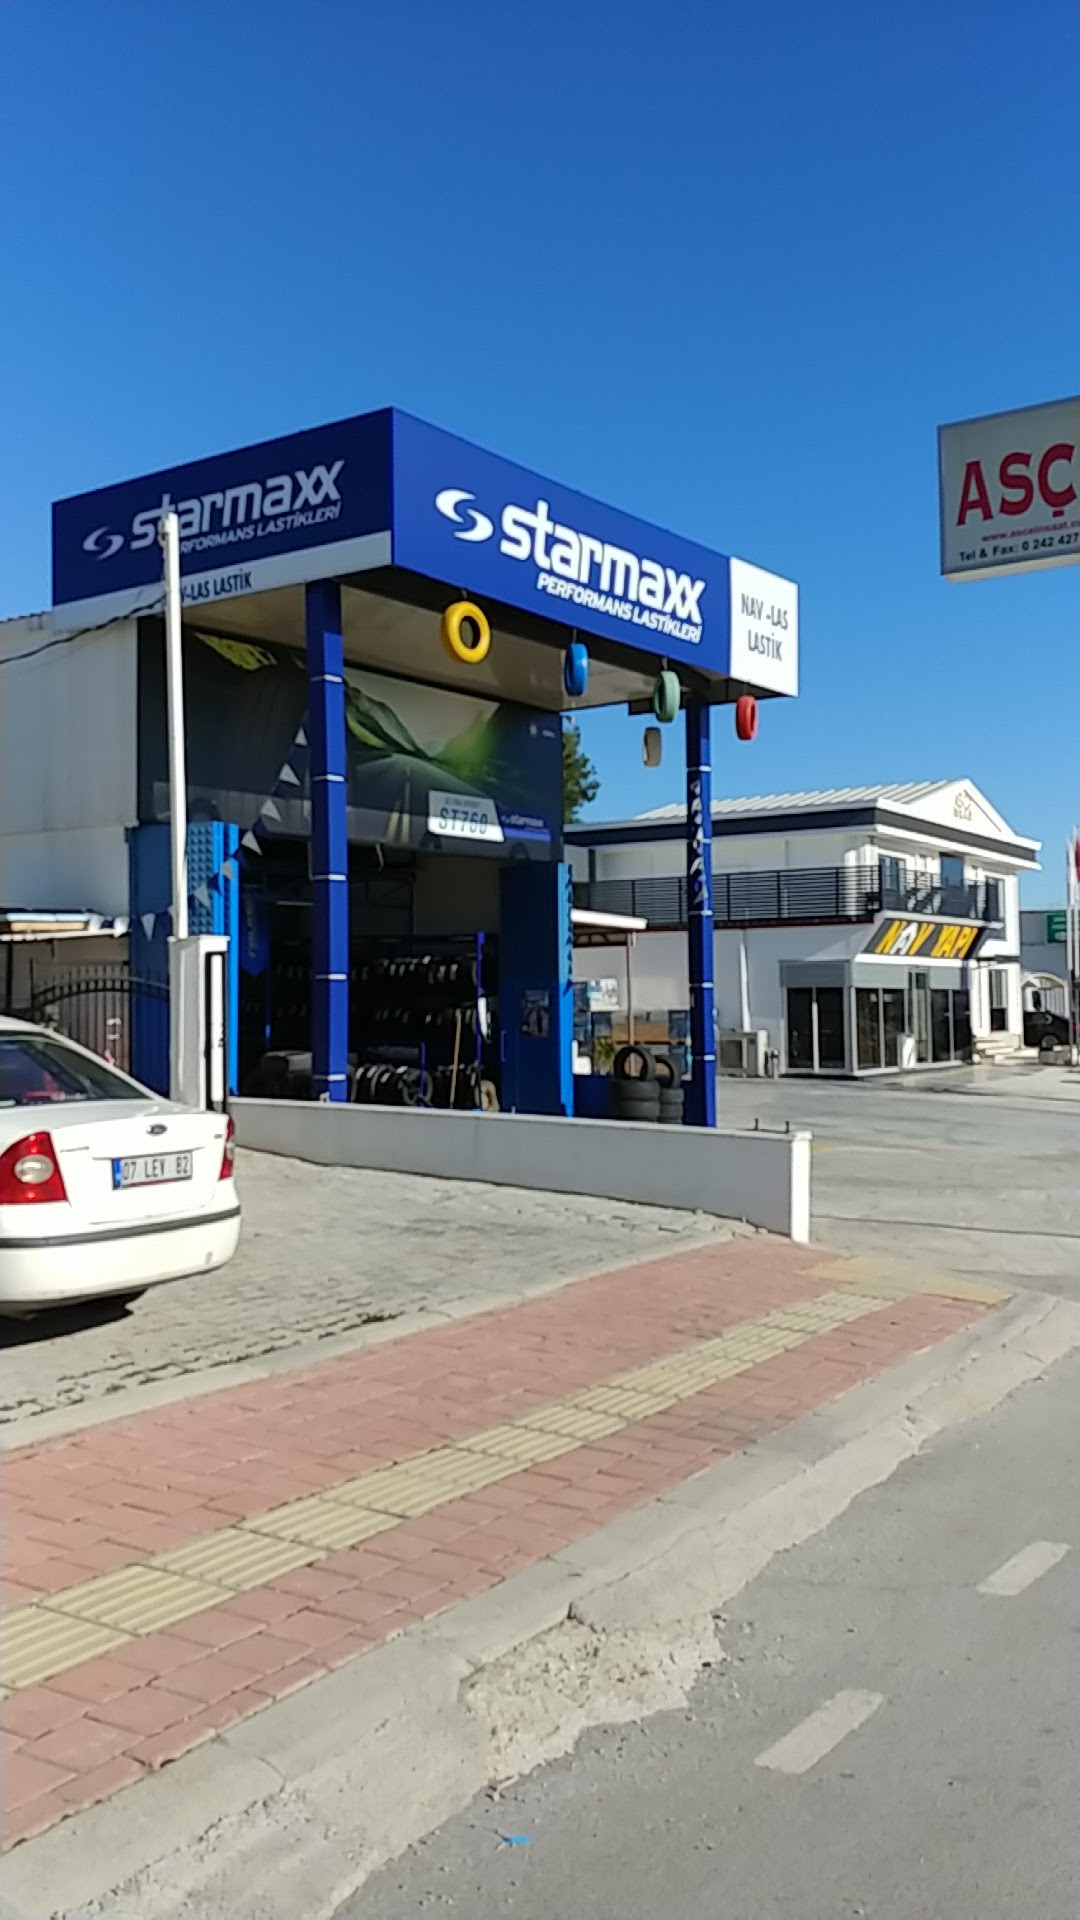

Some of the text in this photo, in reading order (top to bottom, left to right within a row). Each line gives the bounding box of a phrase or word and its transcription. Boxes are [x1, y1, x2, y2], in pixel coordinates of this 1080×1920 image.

[130, 459, 345, 550] starmaxx
[180, 501, 342, 554] RFORMANS LASTİKLERİ
[500, 500, 707, 623] starmaxx
[959, 551, 976, 562] Tel
[979, 548, 988, 559] &
[1021, 540, 1030, 551] 0
[1033, 537, 1055, 549] 242
[1058, 532, 1079, 545] 427
[213, 568, 253, 597] LASTİK
[536, 572, 703, 644] PERFORMANS LASTİKLERİ
[741, 593, 764, 620] NAV
[746, 630, 783, 662] LASTİK
[438, 807, 488, 835] ST760
[874, 919, 979, 960] NAV YAPI
[122, 1161, 137, 1181] 07
